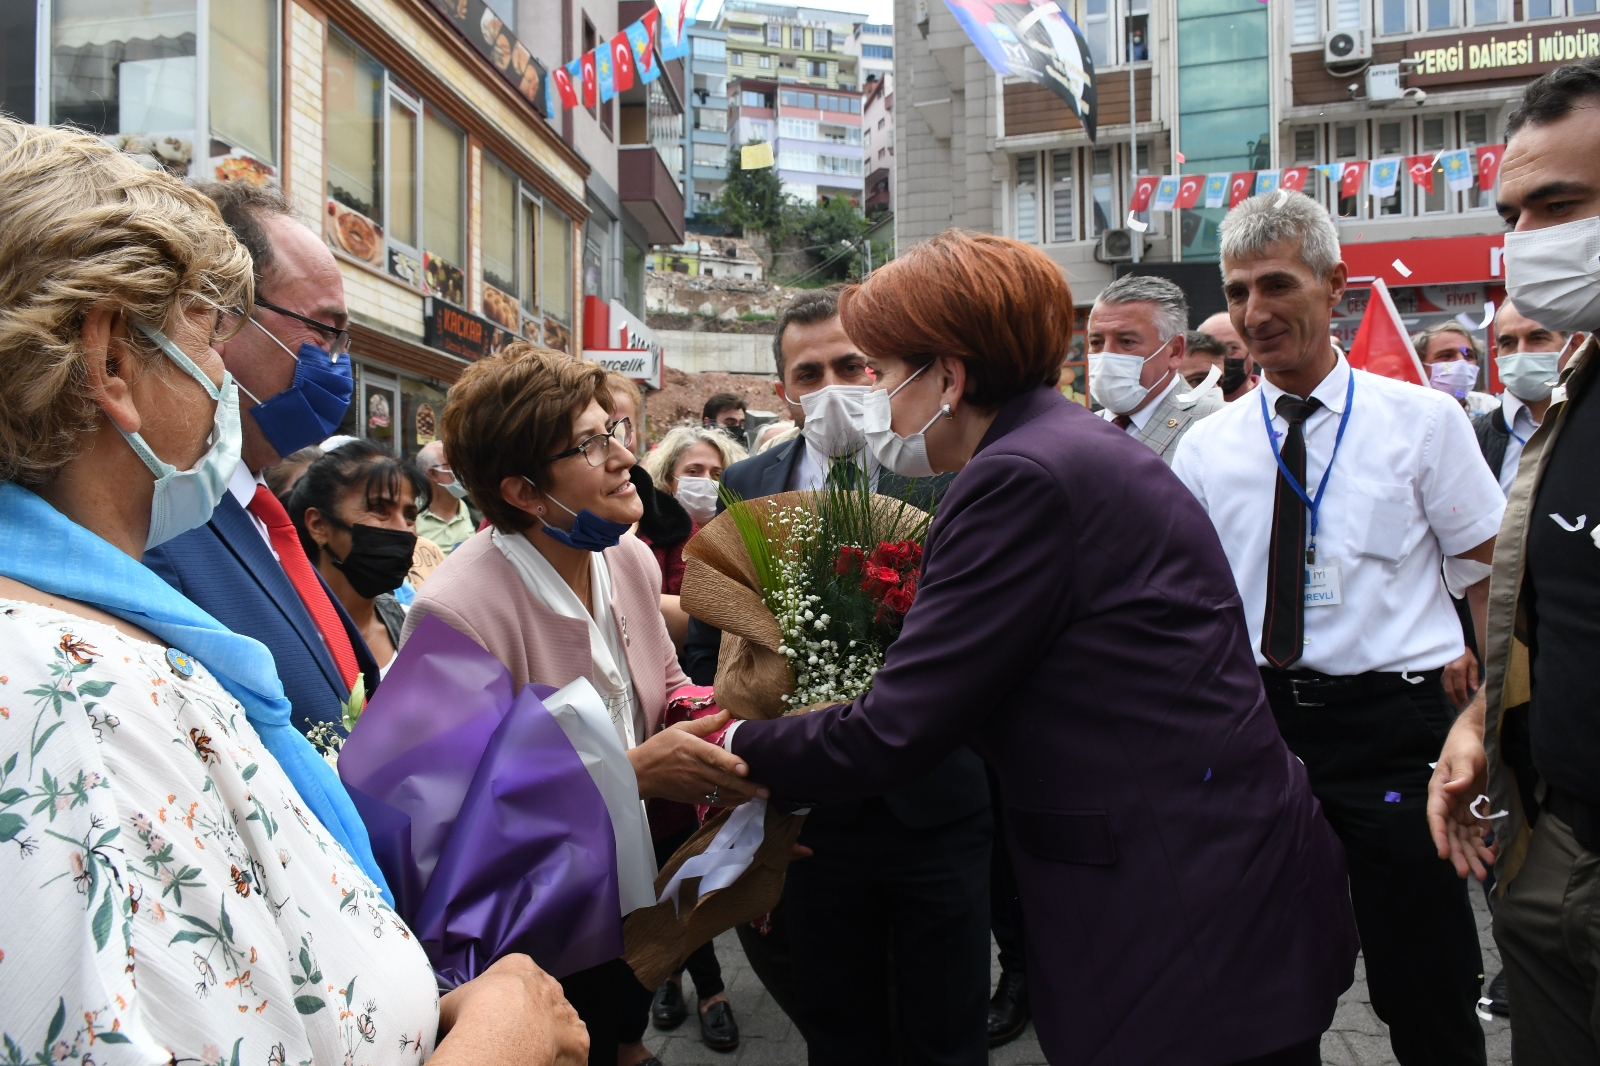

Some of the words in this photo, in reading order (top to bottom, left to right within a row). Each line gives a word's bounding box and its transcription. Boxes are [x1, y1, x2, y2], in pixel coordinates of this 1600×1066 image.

[1414, 40, 1464, 74] VERGİ
[1469, 33, 1533, 70] DAİRESİ
[1539, 28, 1600, 63] MÜDÜR
[1446, 290, 1477, 306] FİYAT
[1313, 569, 1325, 579] İYİ
